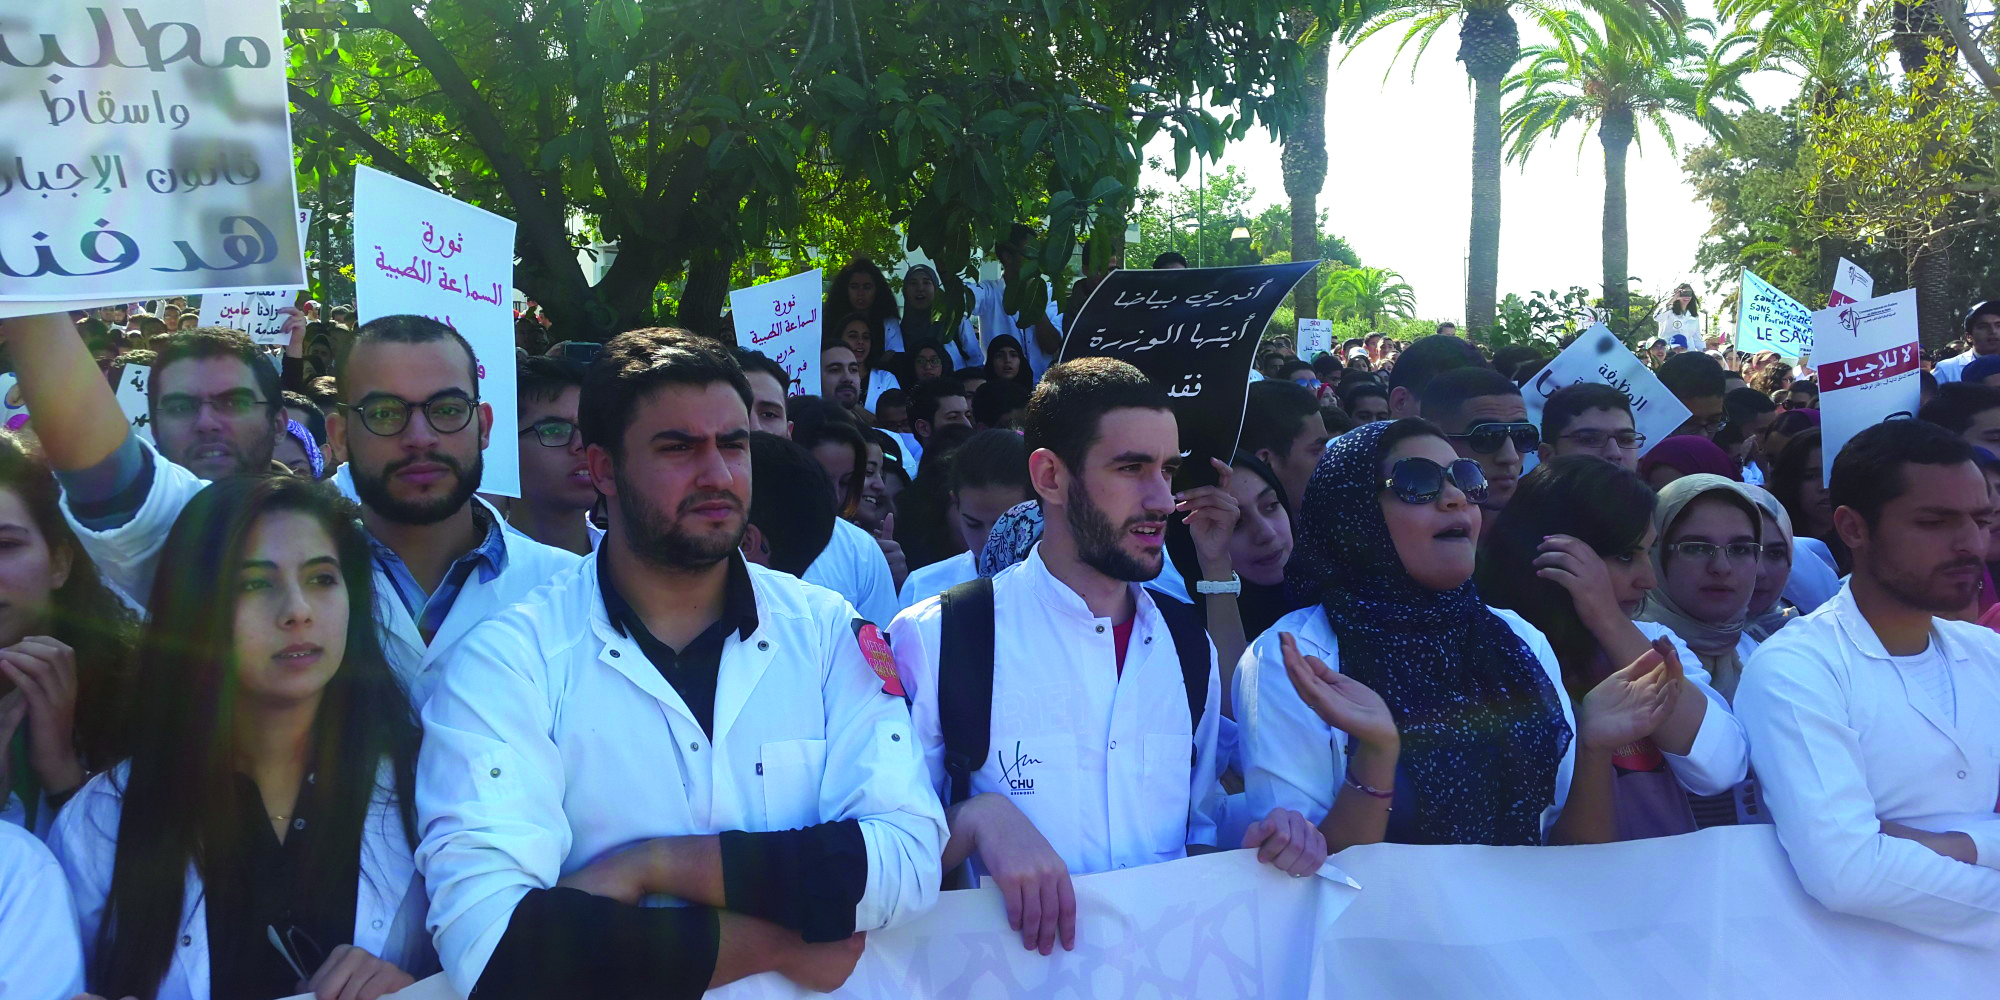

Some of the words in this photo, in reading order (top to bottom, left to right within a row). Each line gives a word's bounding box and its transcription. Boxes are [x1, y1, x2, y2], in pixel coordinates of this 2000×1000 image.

[421, 221, 463, 258] ثورة
[375, 245, 431, 284] الطبية
[438, 265, 502, 306] السماعة
[773, 294, 796, 316] ثورة
[785, 308, 817, 332] السماعة
[1190, 312, 1256, 349] أيتها
[750, 321, 782, 346] الطبية
[1757, 327, 1772, 341] LE
[1902, 345, 1911, 363] لا
[1834, 350, 1898, 386] للإجبار
[1167, 373, 1202, 397] فقد
[1010, 779, 1034, 789] CHU
